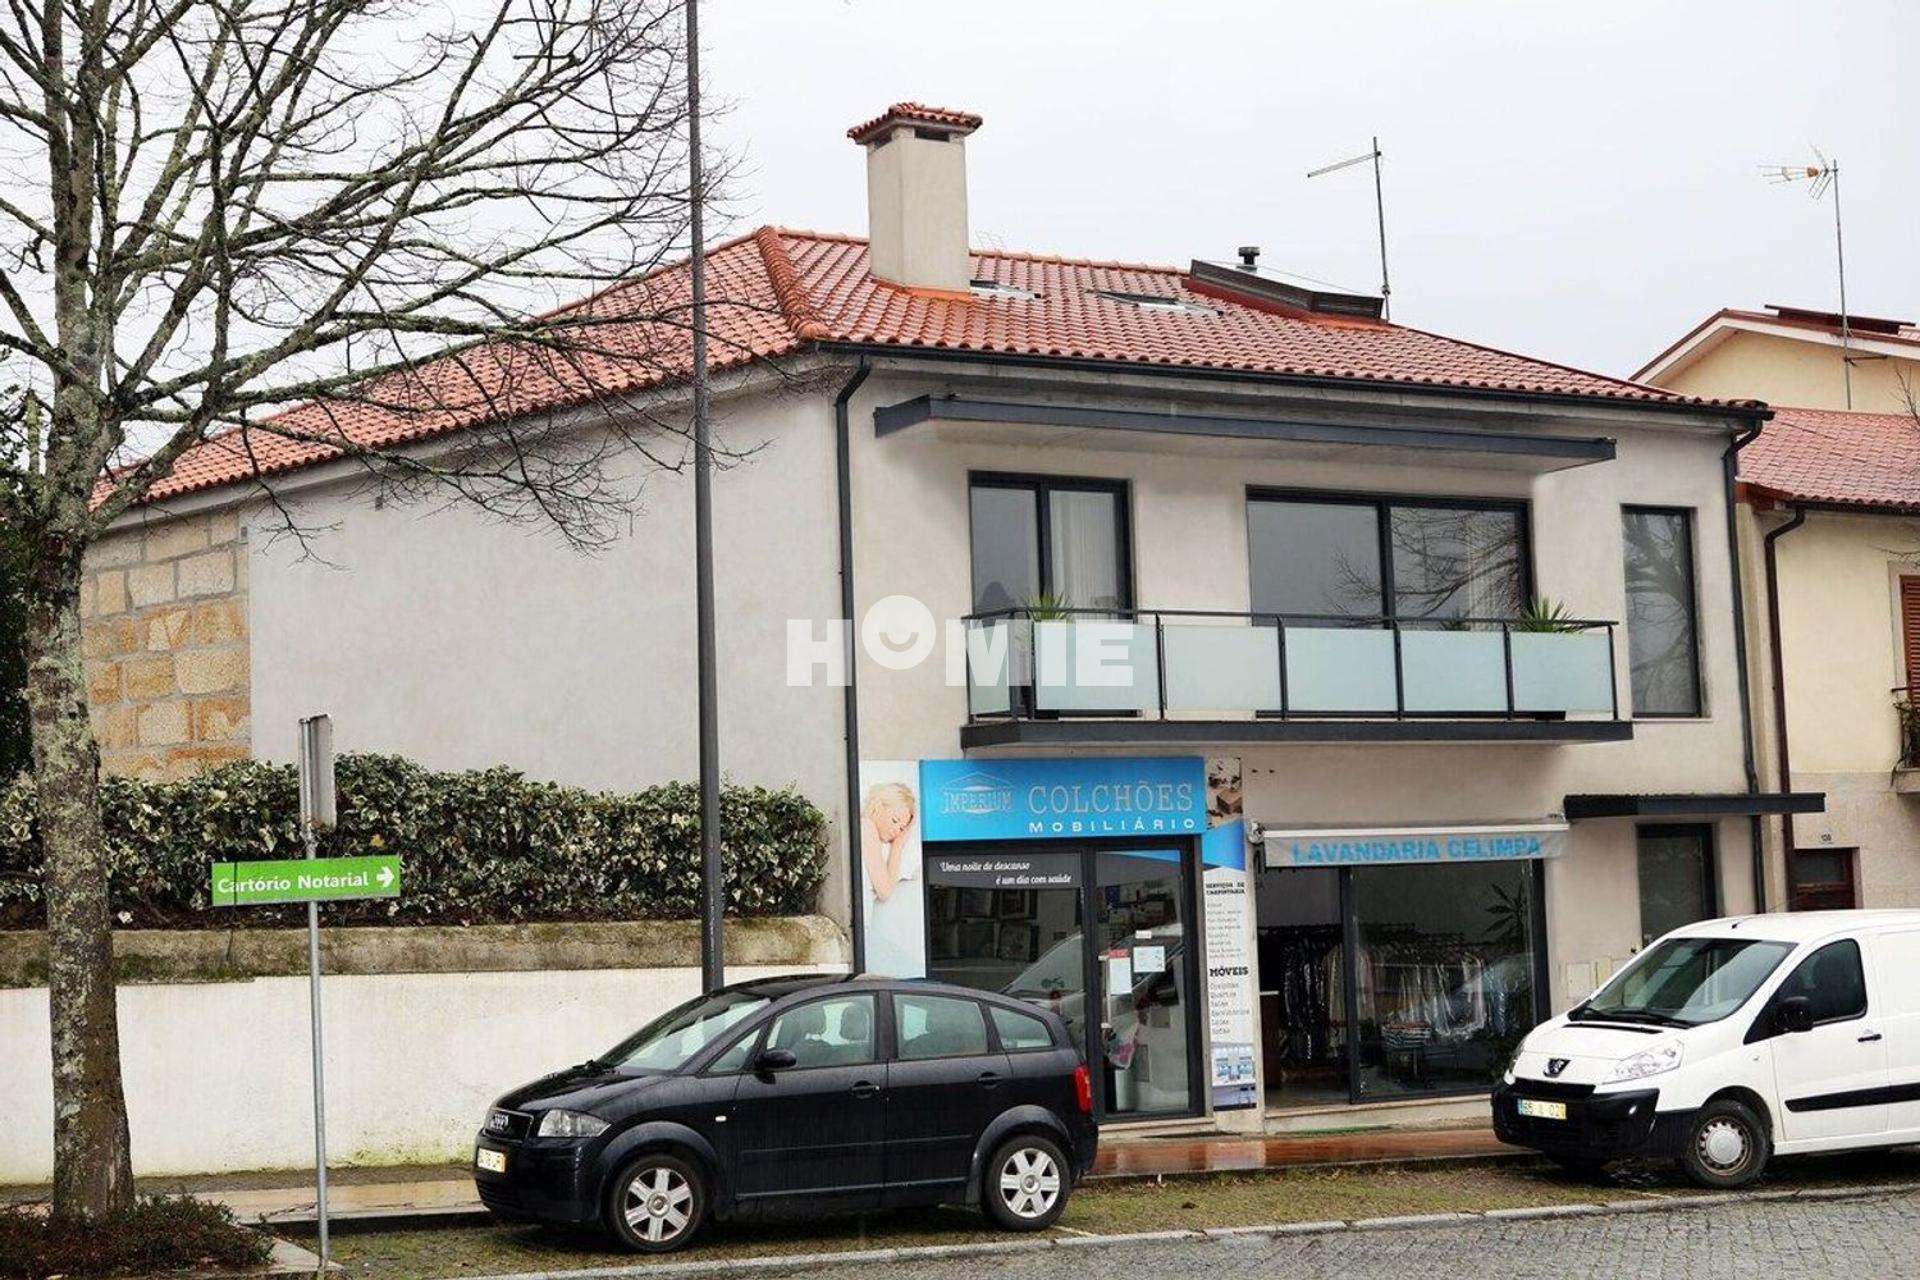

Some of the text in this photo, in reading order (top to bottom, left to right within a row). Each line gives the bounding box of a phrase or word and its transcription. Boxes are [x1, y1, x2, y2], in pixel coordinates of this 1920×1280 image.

[1028, 780, 1194, 815] COLCHÕES
[1028, 817, 1195, 833] MOBILIÁRIO
[1292, 838, 1441, 864] LAVANDARIA
[940, 861, 1031, 872] Uma noite de descanso
[217, 871, 369, 894] Cartório Notarial
[1016, 875, 1030, 884] dia
[1047, 873, 1072, 883] saúde
[1209, 966, 1249, 977] MÓVEIS
